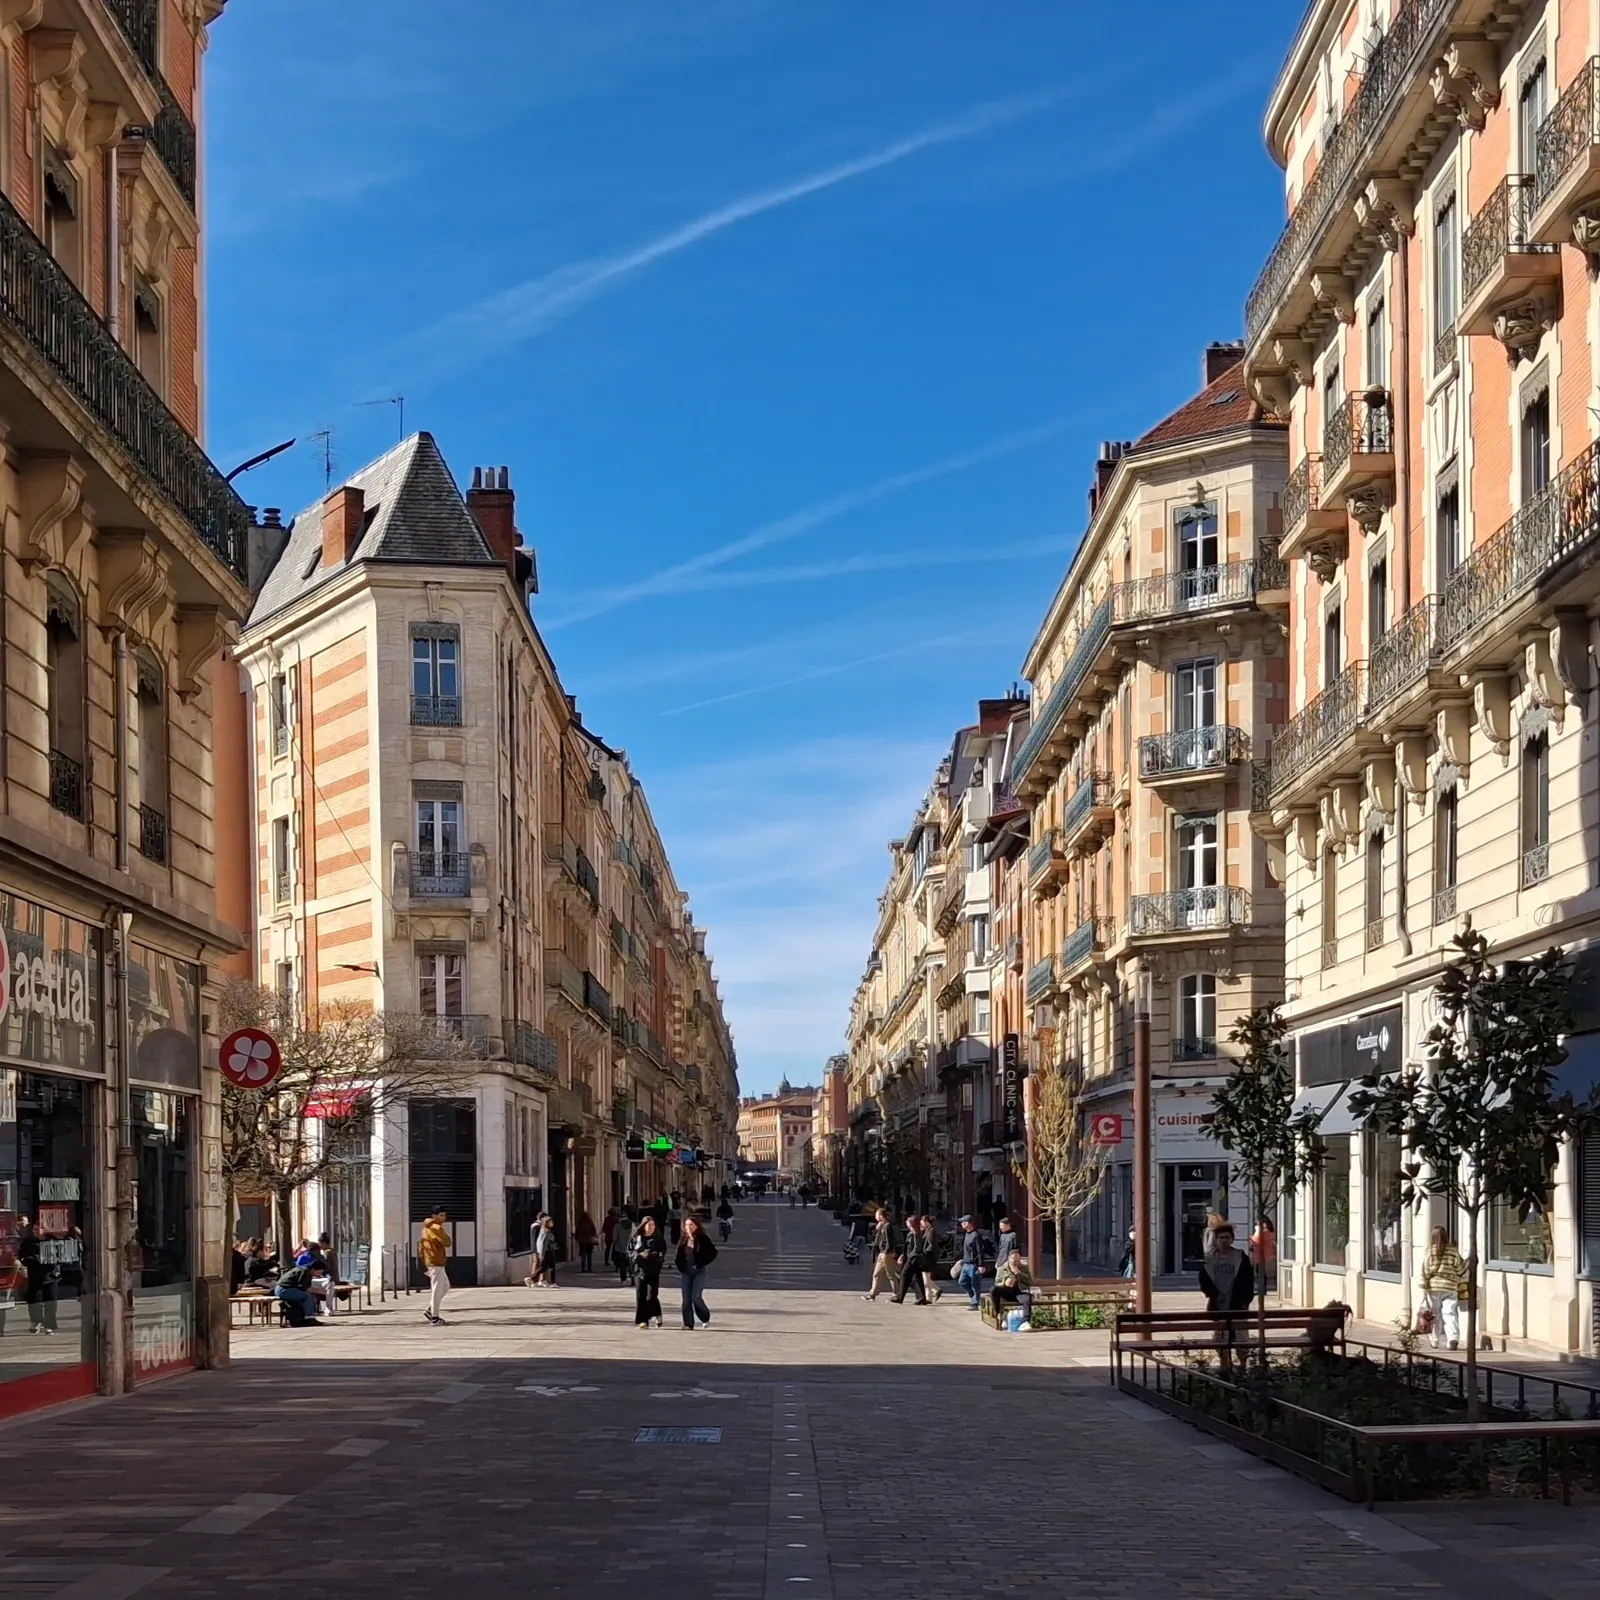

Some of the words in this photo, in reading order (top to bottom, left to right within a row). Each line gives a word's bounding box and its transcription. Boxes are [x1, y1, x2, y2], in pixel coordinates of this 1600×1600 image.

[15, 951, 89, 1023] actual
[1006, 1040, 1016, 1066] CITY
[1006, 1070, 1016, 1108] CLINIC
[1098, 1117, 1116, 1136] C
[1158, 1112, 1212, 1126] cuisin
[141, 1304, 190, 1371] actual
